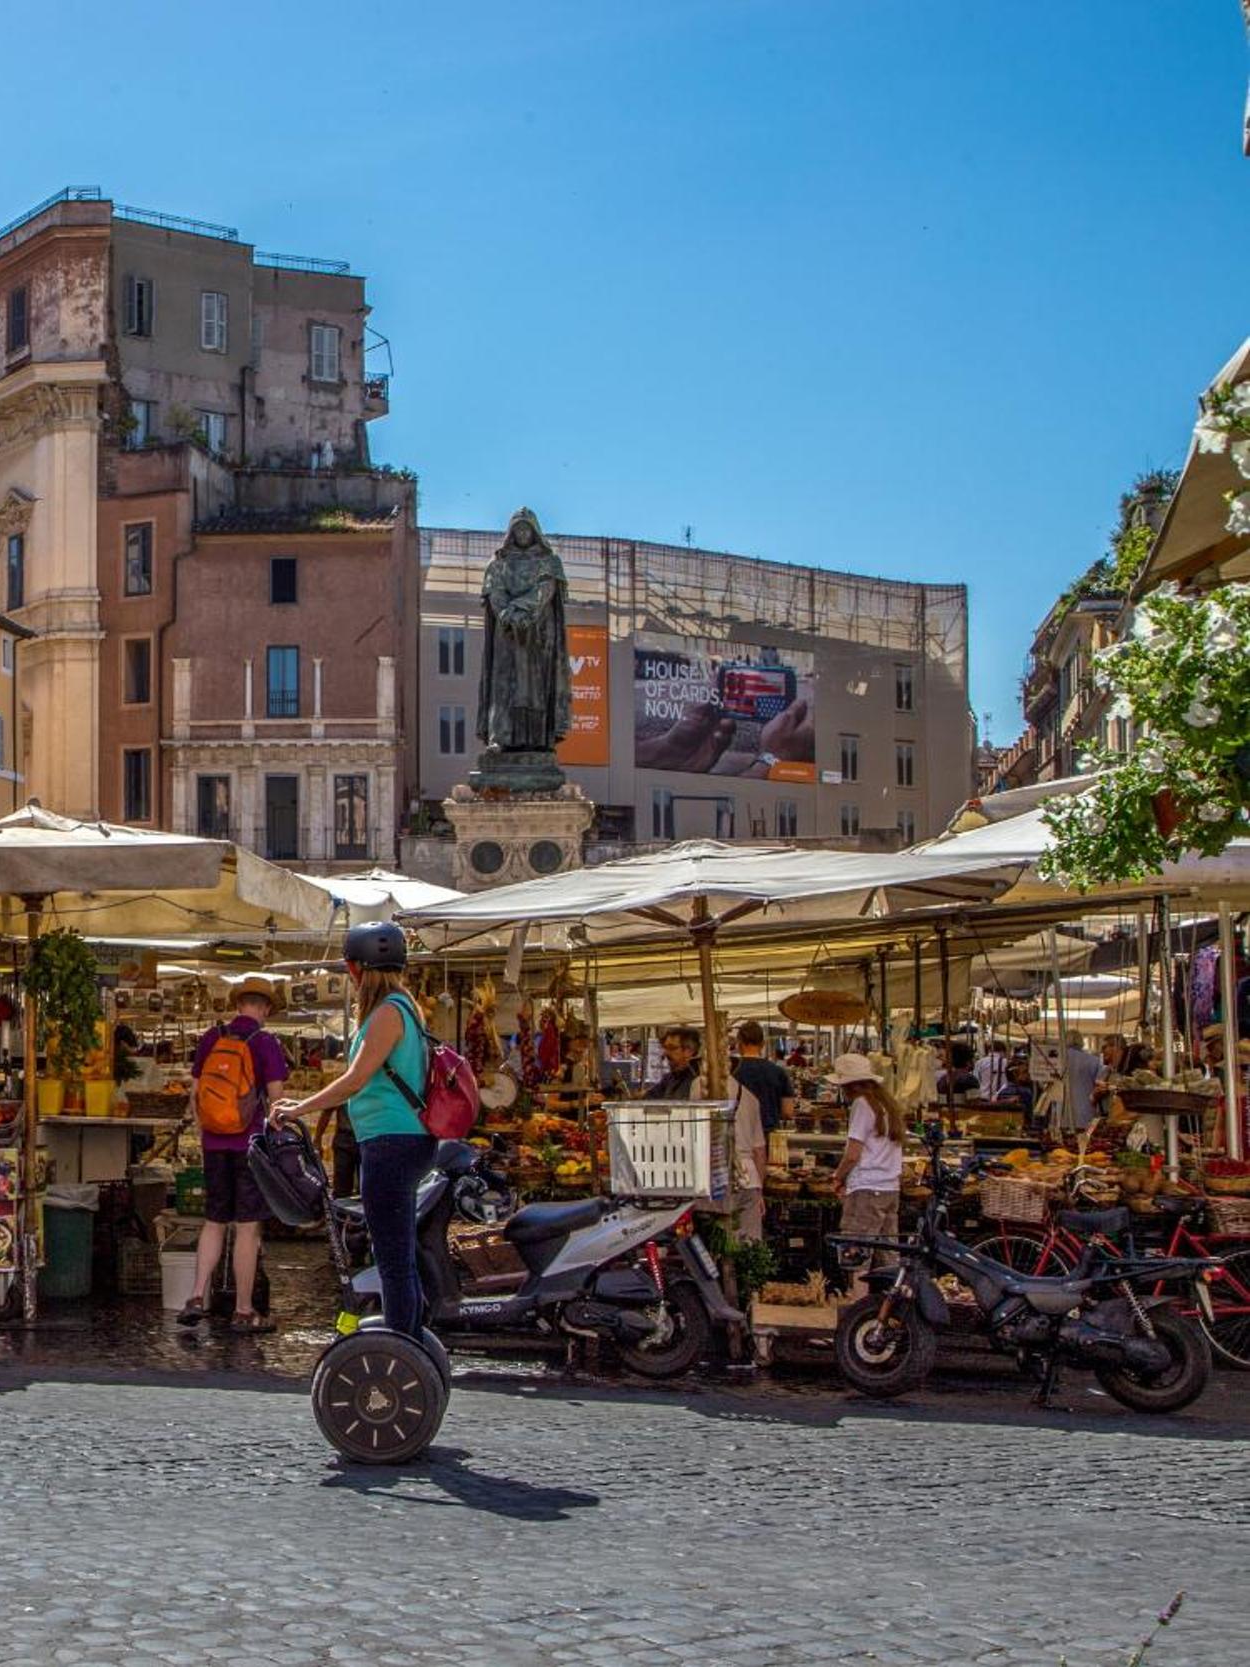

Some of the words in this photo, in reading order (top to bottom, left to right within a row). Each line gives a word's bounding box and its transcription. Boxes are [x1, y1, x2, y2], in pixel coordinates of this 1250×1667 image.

[645, 660, 700, 681] HOUSE
[645, 680, 668, 698] OF
[670, 682, 725, 709] CARDS,
[645, 700, 686, 720] NOW.
[460, 1303, 501, 1316] KYMCO
